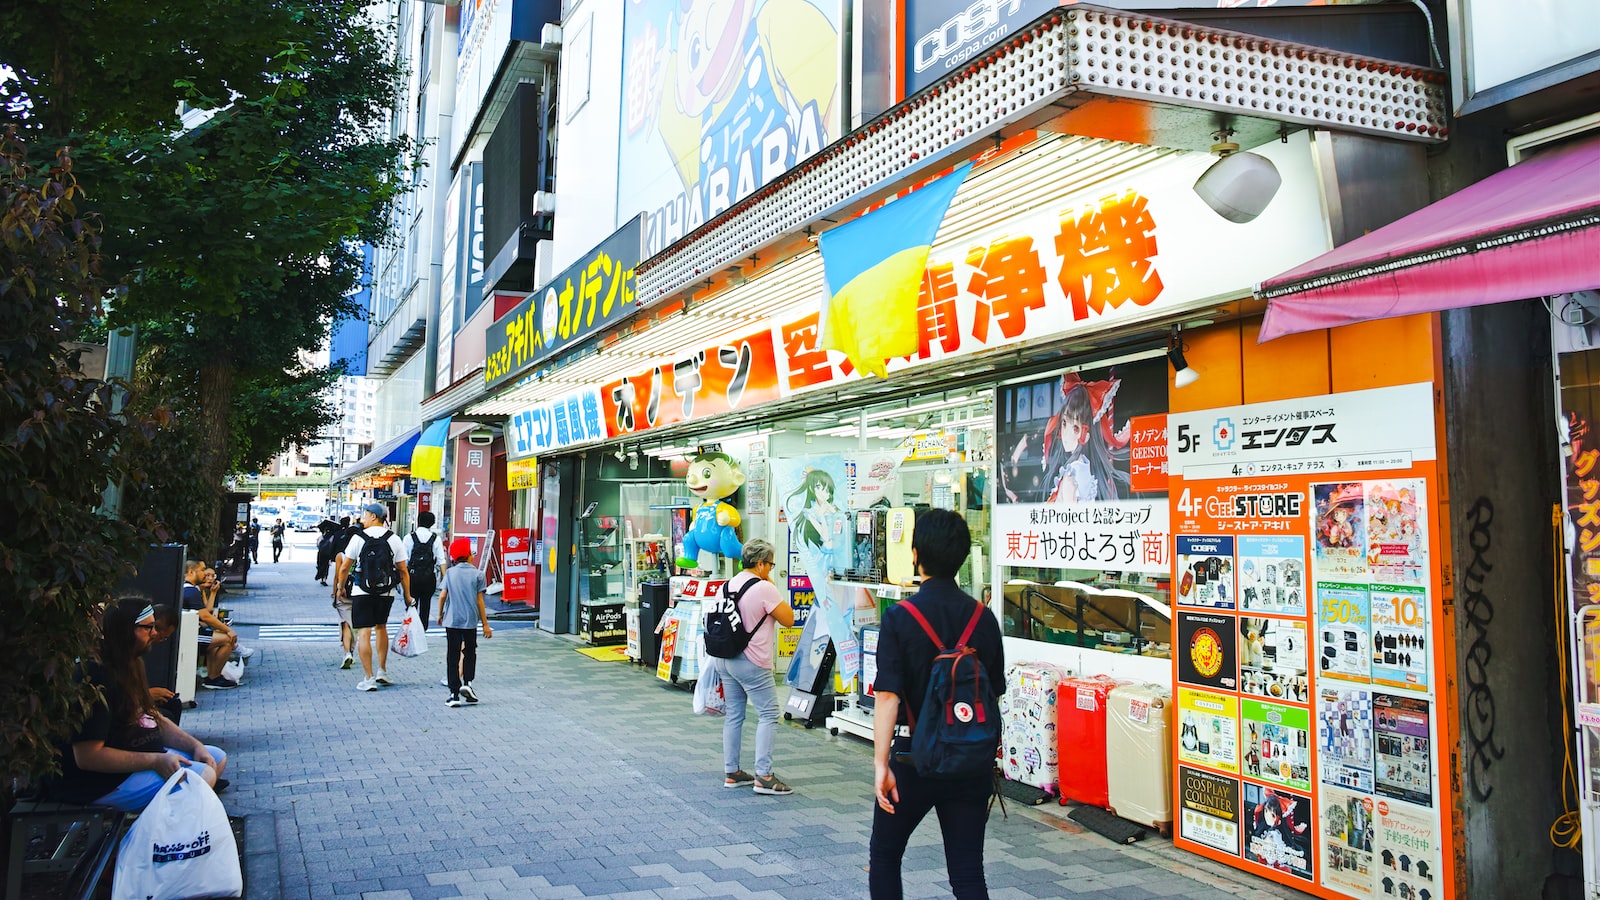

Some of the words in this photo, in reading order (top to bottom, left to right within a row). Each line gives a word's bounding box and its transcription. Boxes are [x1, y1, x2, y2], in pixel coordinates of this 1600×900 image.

[945, 24, 1008, 69] cospa.com
[558, 251, 641, 340] オノデンに
[613, 341, 750, 432] オノデン
[514, 406, 553, 453] エアコン
[555, 390, 601, 446] 扇風機
[1177, 424, 1200, 453] 5F
[1241, 423, 1338, 450] エンタス
[1231, 463, 1243, 476] 4F
[463, 449, 484, 525] 周大福
[1029, 508, 1090, 526] 東方Project
[1092, 504, 1152, 525] 公認ショップ
[1177, 487, 1203, 517] 4F
[1217, 520, 1291, 531] ジーストア・アキバ
[790, 578, 806, 587] B1F
[595, 612, 622, 621] AirPods
[1185, 789, 1233, 812] COUNTER
[1186, 777, 1231, 798] COSPLAY
